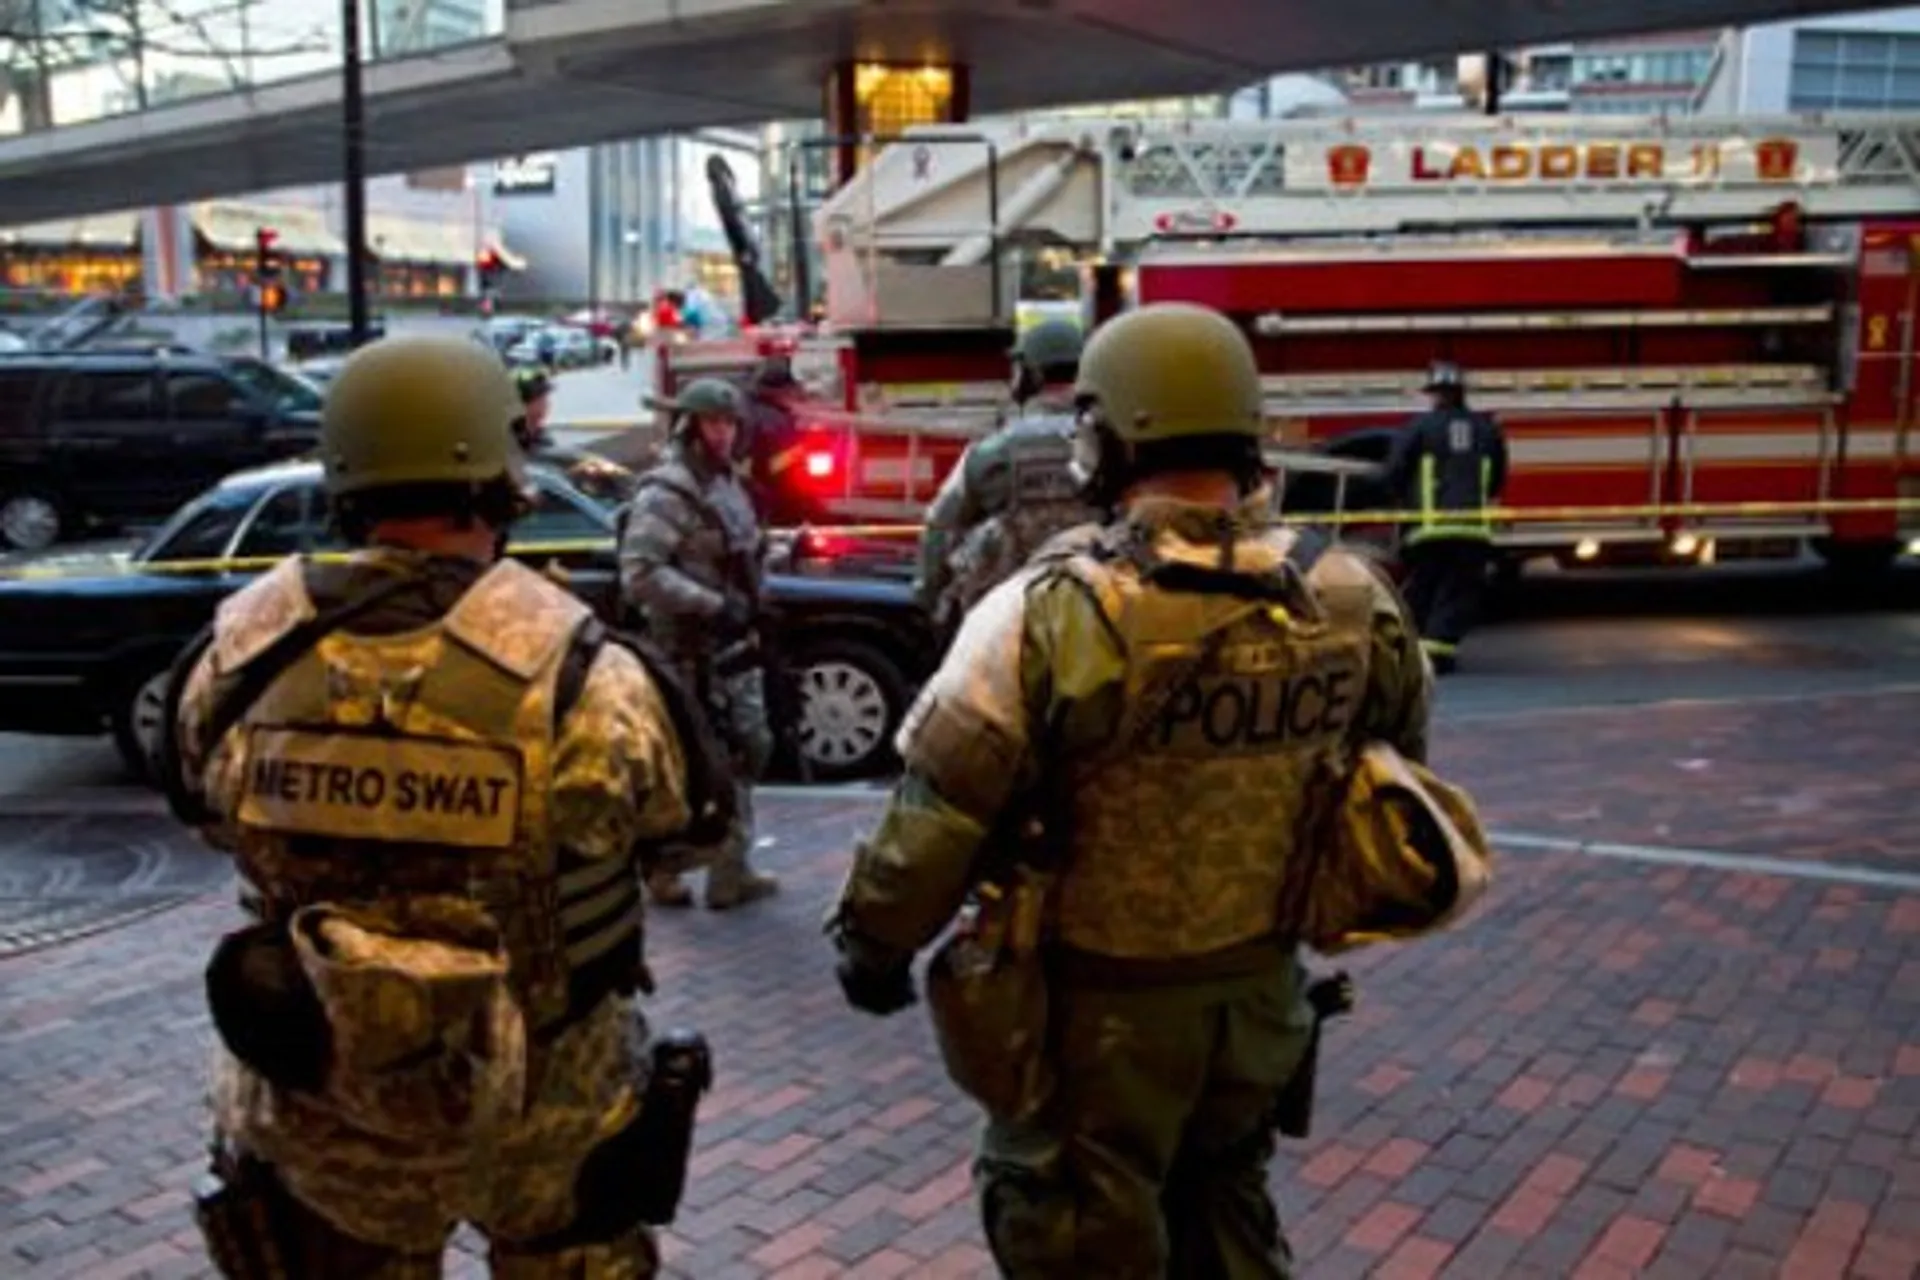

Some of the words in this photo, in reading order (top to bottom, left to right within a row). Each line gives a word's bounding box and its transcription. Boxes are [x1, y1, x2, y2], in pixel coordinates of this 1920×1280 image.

[1411, 145, 1664, 180] LADDER
[1159, 671, 1353, 745] POLICE
[253, 757, 386, 807] METRO
[396, 771, 509, 819] SWAT
